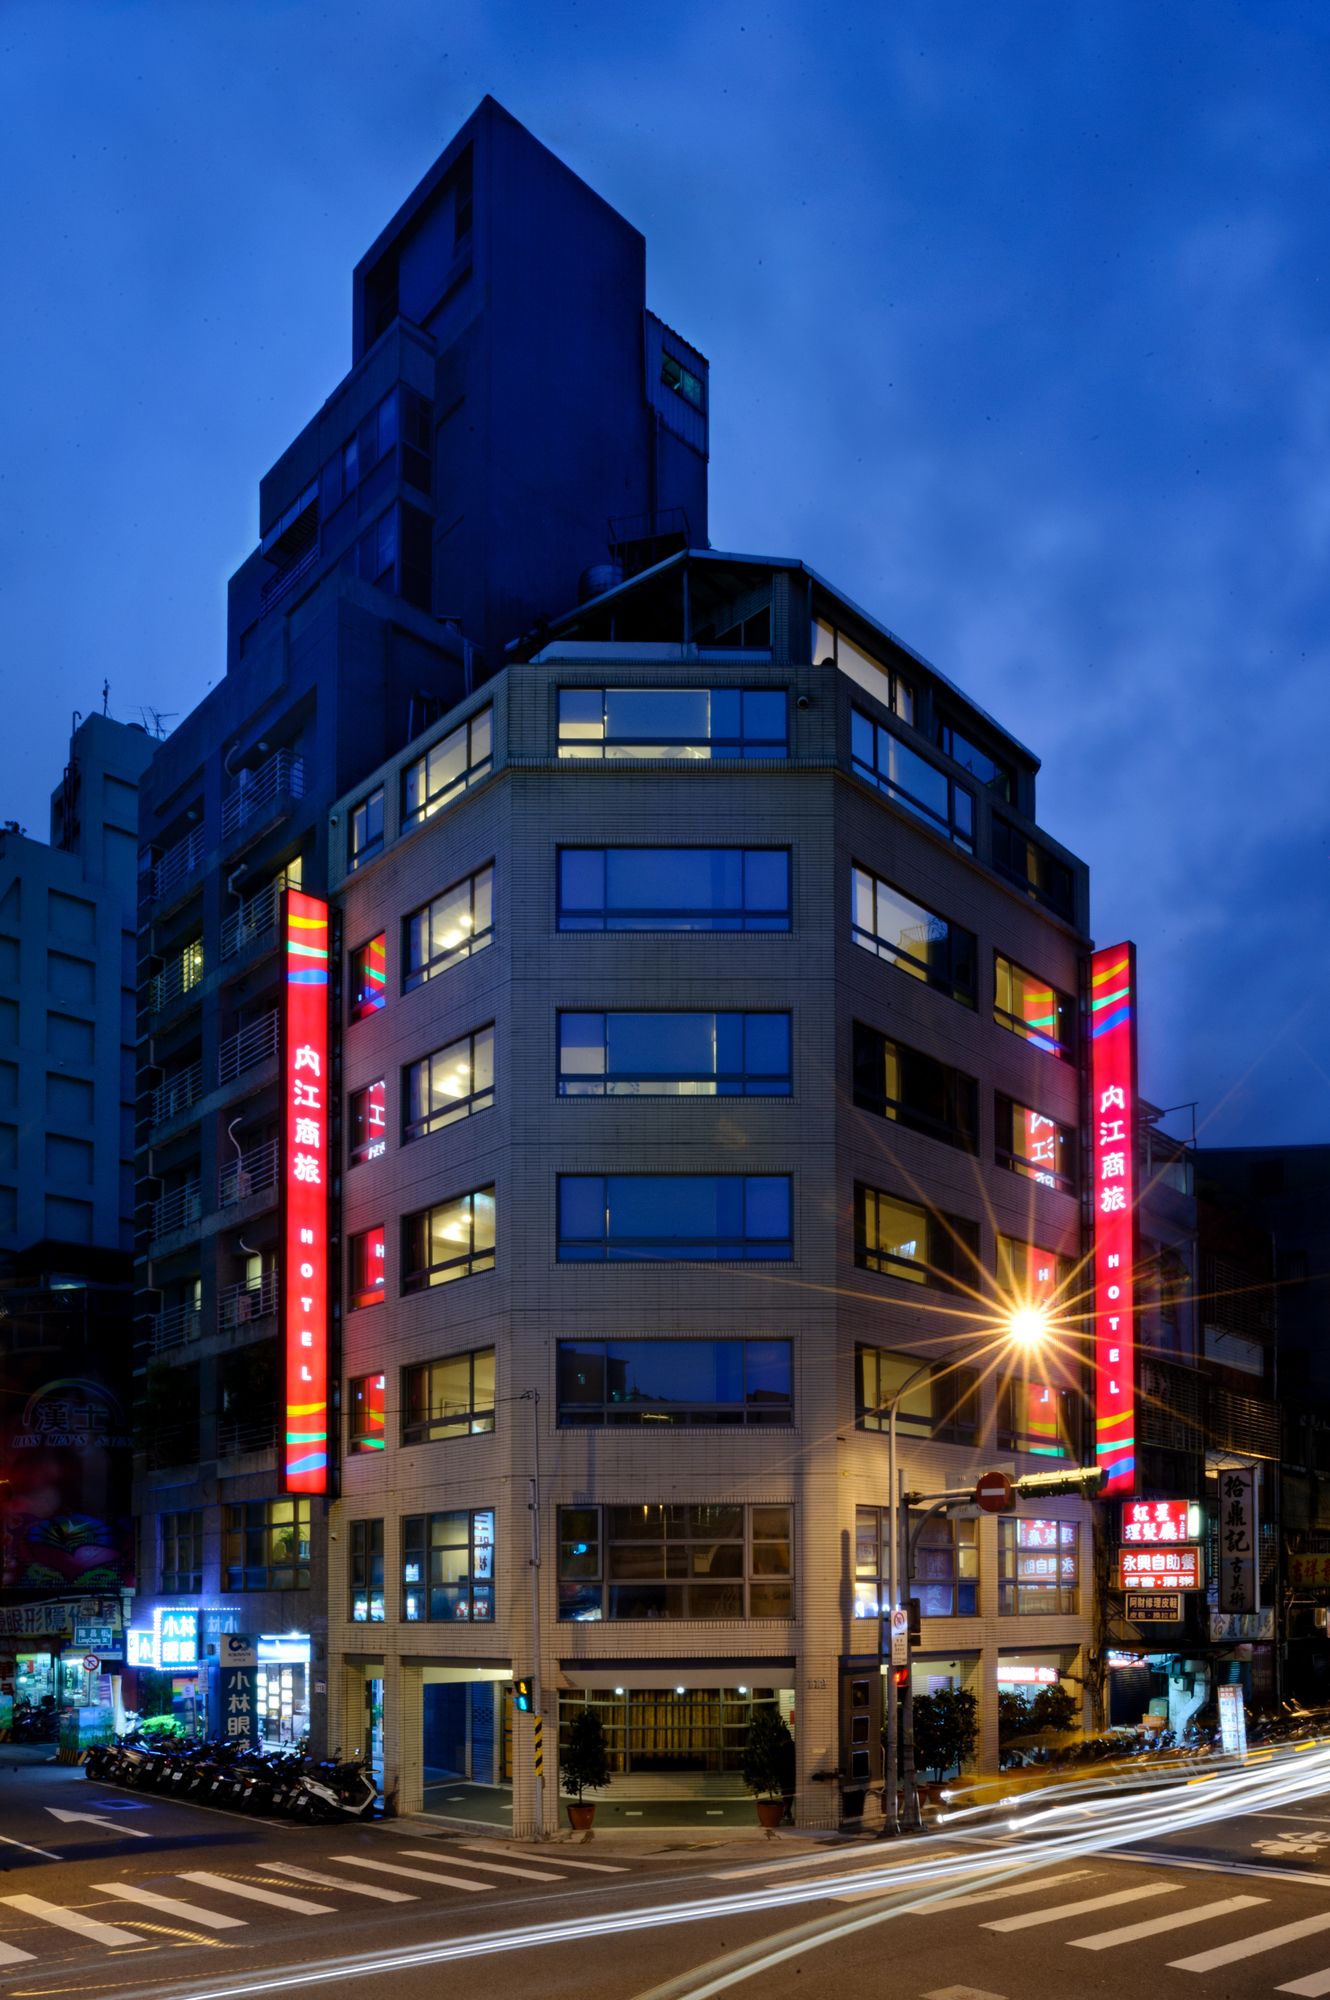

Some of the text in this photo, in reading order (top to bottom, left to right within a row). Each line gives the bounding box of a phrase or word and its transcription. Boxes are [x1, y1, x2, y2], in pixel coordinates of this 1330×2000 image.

[300, 1228, 313, 1381] HOTEL
[1108, 1254, 1120, 1393] HOTEL
[36, 1401, 109, 1433] 漢士
[1123, 1553, 1195, 1572] 永興自助餐
[162, 1615, 197, 1638] 小林
